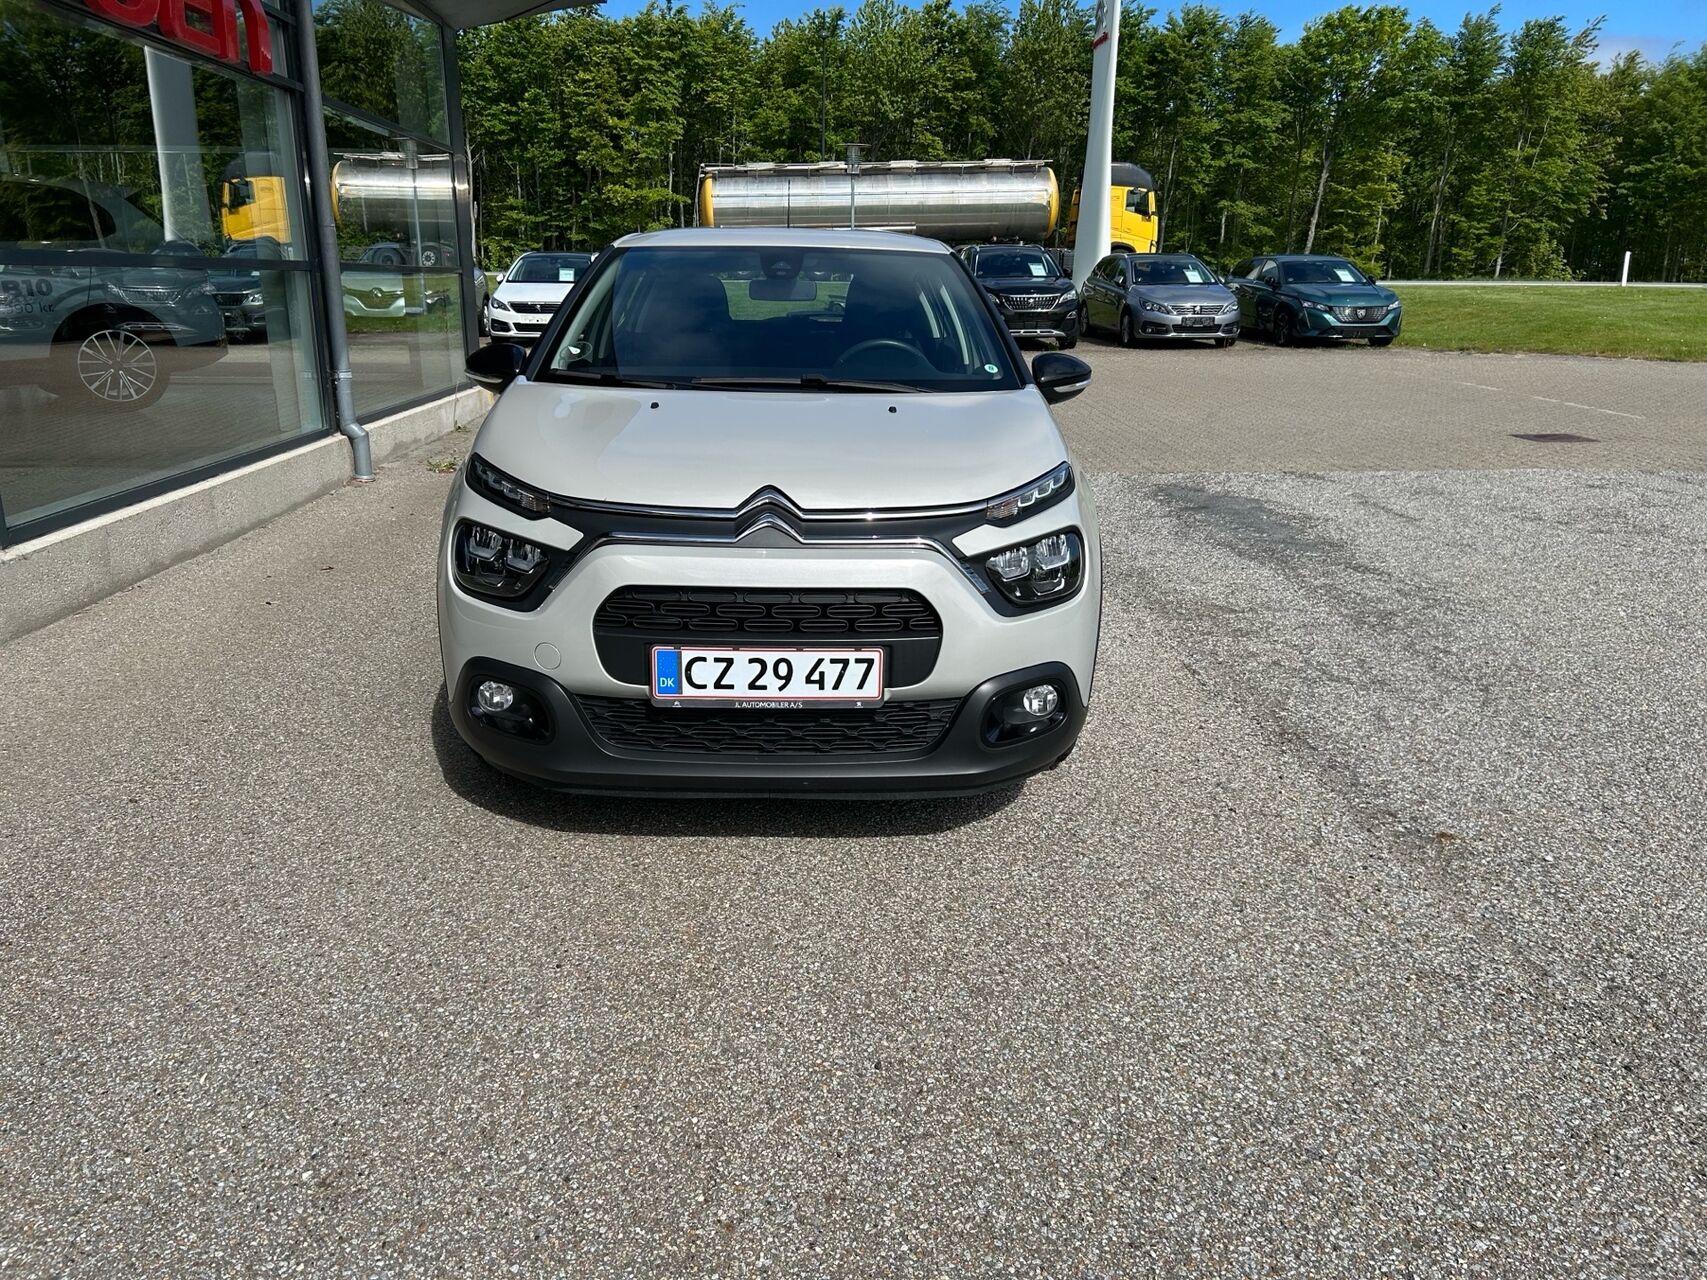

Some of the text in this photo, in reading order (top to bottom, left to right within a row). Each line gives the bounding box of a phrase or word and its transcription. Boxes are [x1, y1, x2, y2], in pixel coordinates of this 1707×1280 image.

[684, 656, 875, 692] CZ 29 477
[660, 677, 675, 688] DK
[742, 701, 789, 709] AUTOMOBILER
[790, 701, 803, 709] A/S
